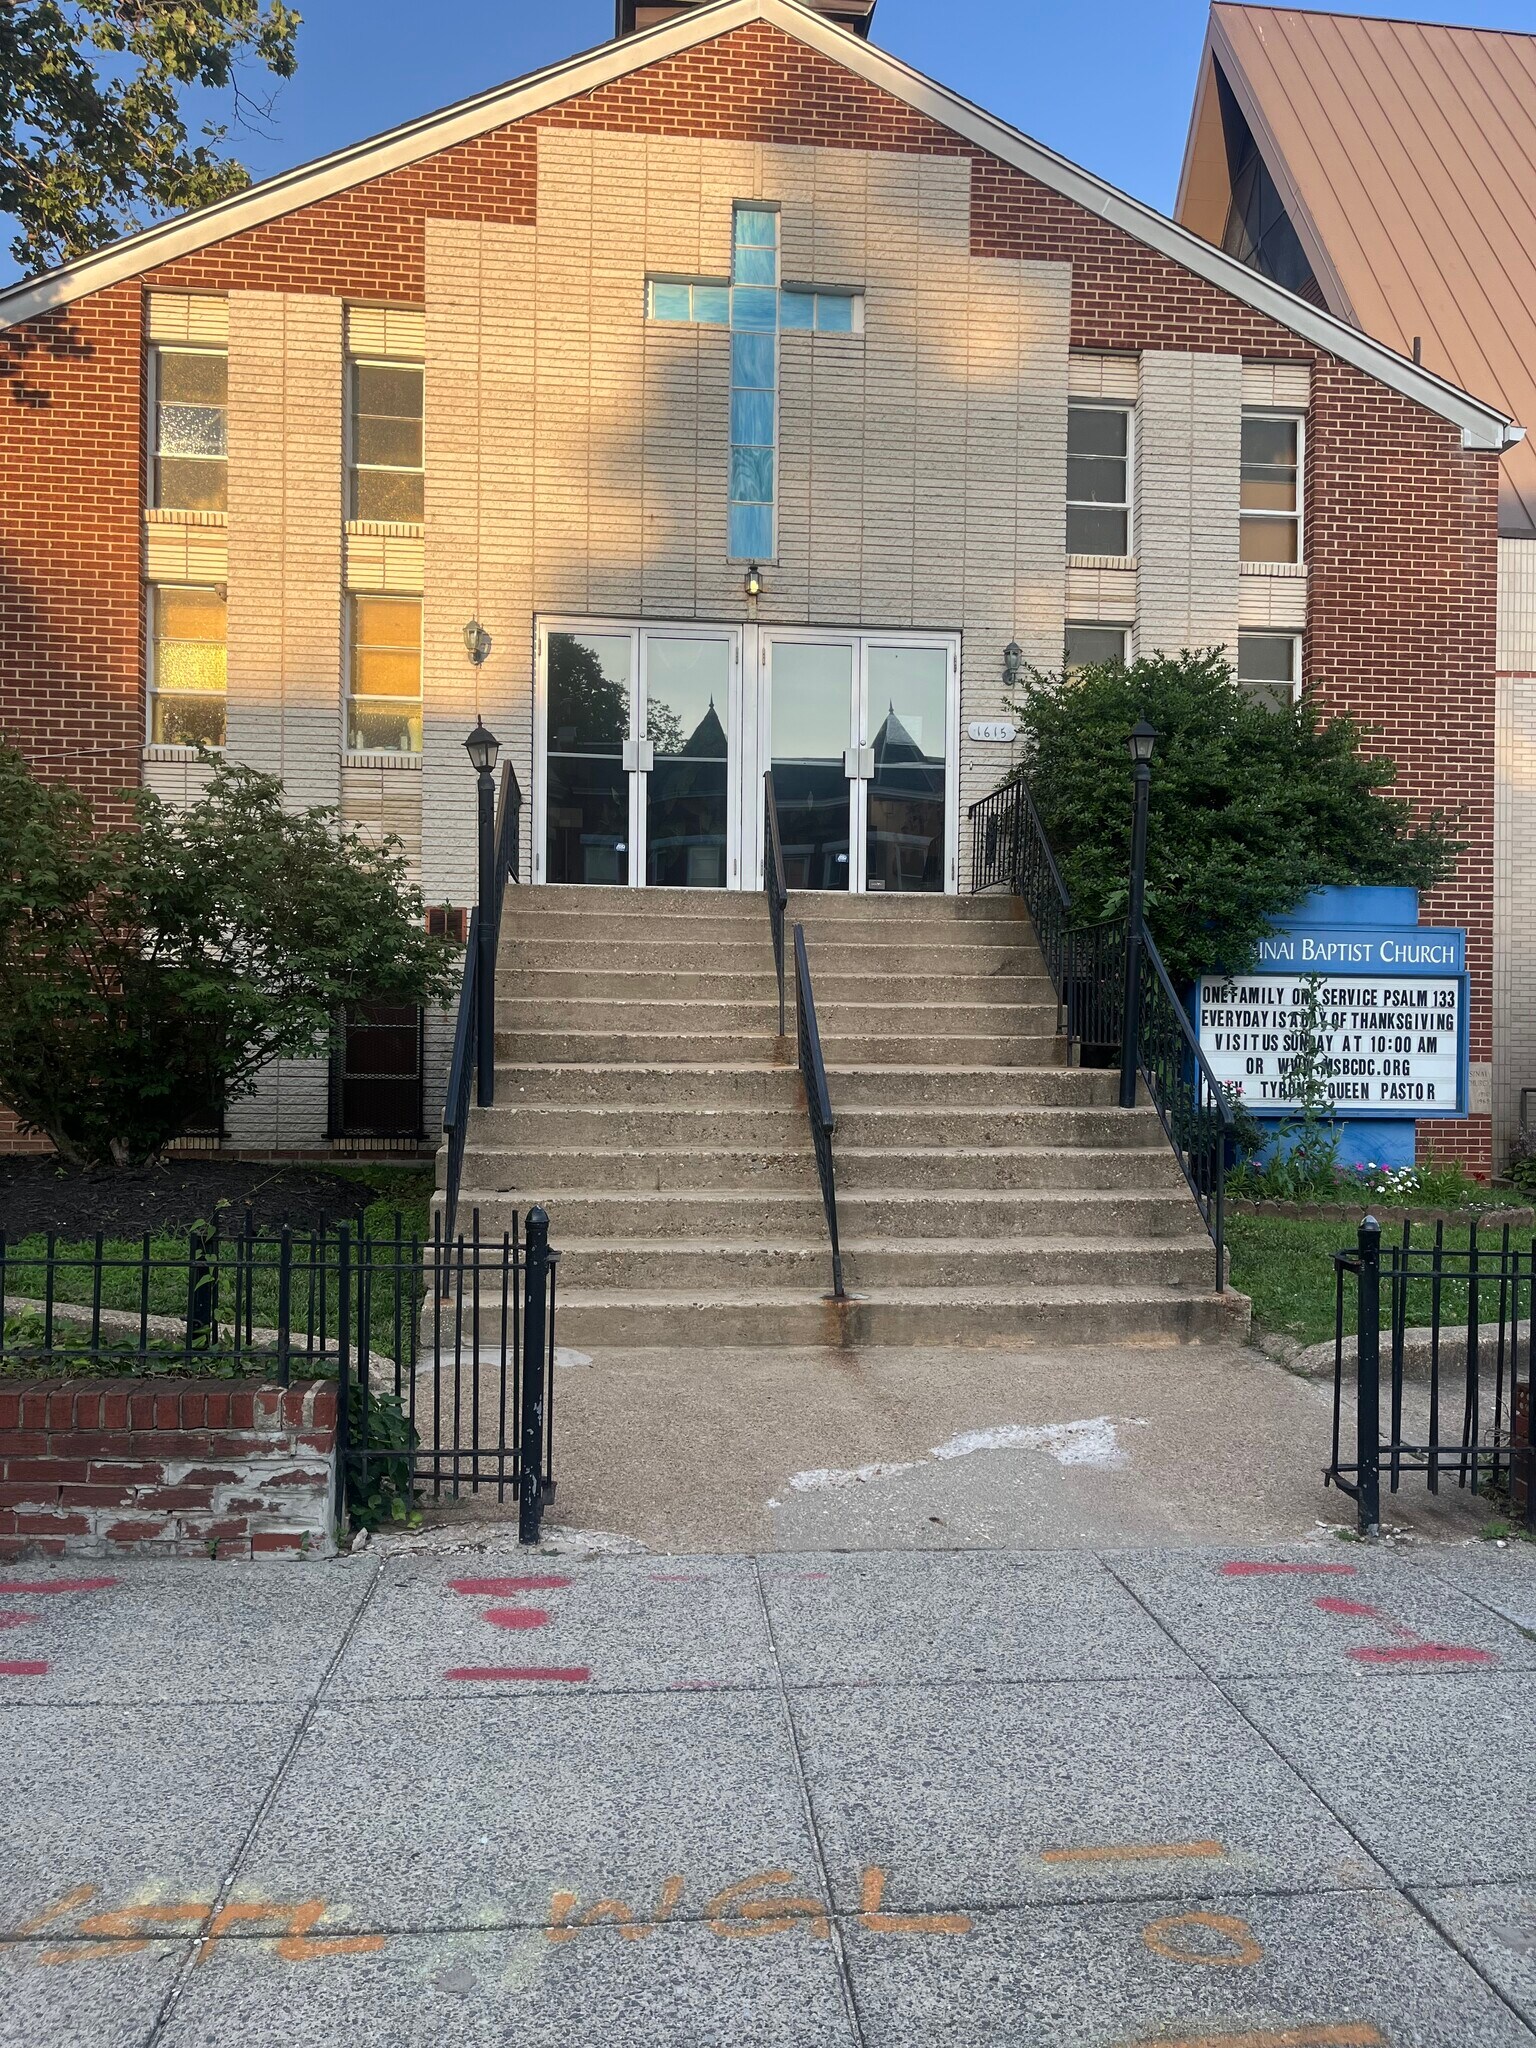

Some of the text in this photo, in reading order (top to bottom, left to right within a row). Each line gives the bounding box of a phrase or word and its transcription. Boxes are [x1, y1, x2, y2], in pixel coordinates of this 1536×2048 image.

[976, 726, 1007, 739] 1615
[1301, 938, 1374, 962] BAPTIST
[1380, 940, 1455, 963] CHURCH
[1292, 987, 1318, 1005] ON
[1322, 988, 1378, 1006] SERVICE
[1383, 989, 1428, 1007] PSALM
[1433, 990, 1455, 1008] 133
[1201, 1009, 1269, 1028] EVERYDAY
[1300, 1011, 1328, 1028] DY
[1331, 1011, 1347, 1029] OF
[1351, 1012, 1454, 1030] THANKSGIVING
[1215, 1033, 1438, 1054] VISIT US SUNAY AT 10:00 AM
[1246, 1057, 1264, 1075] OR
[1260, 1080, 1310, 1099] TYRON
[1327, 1082, 1370, 1100] QUEEN
[1381, 1082, 1436, 1100] PASTOR
